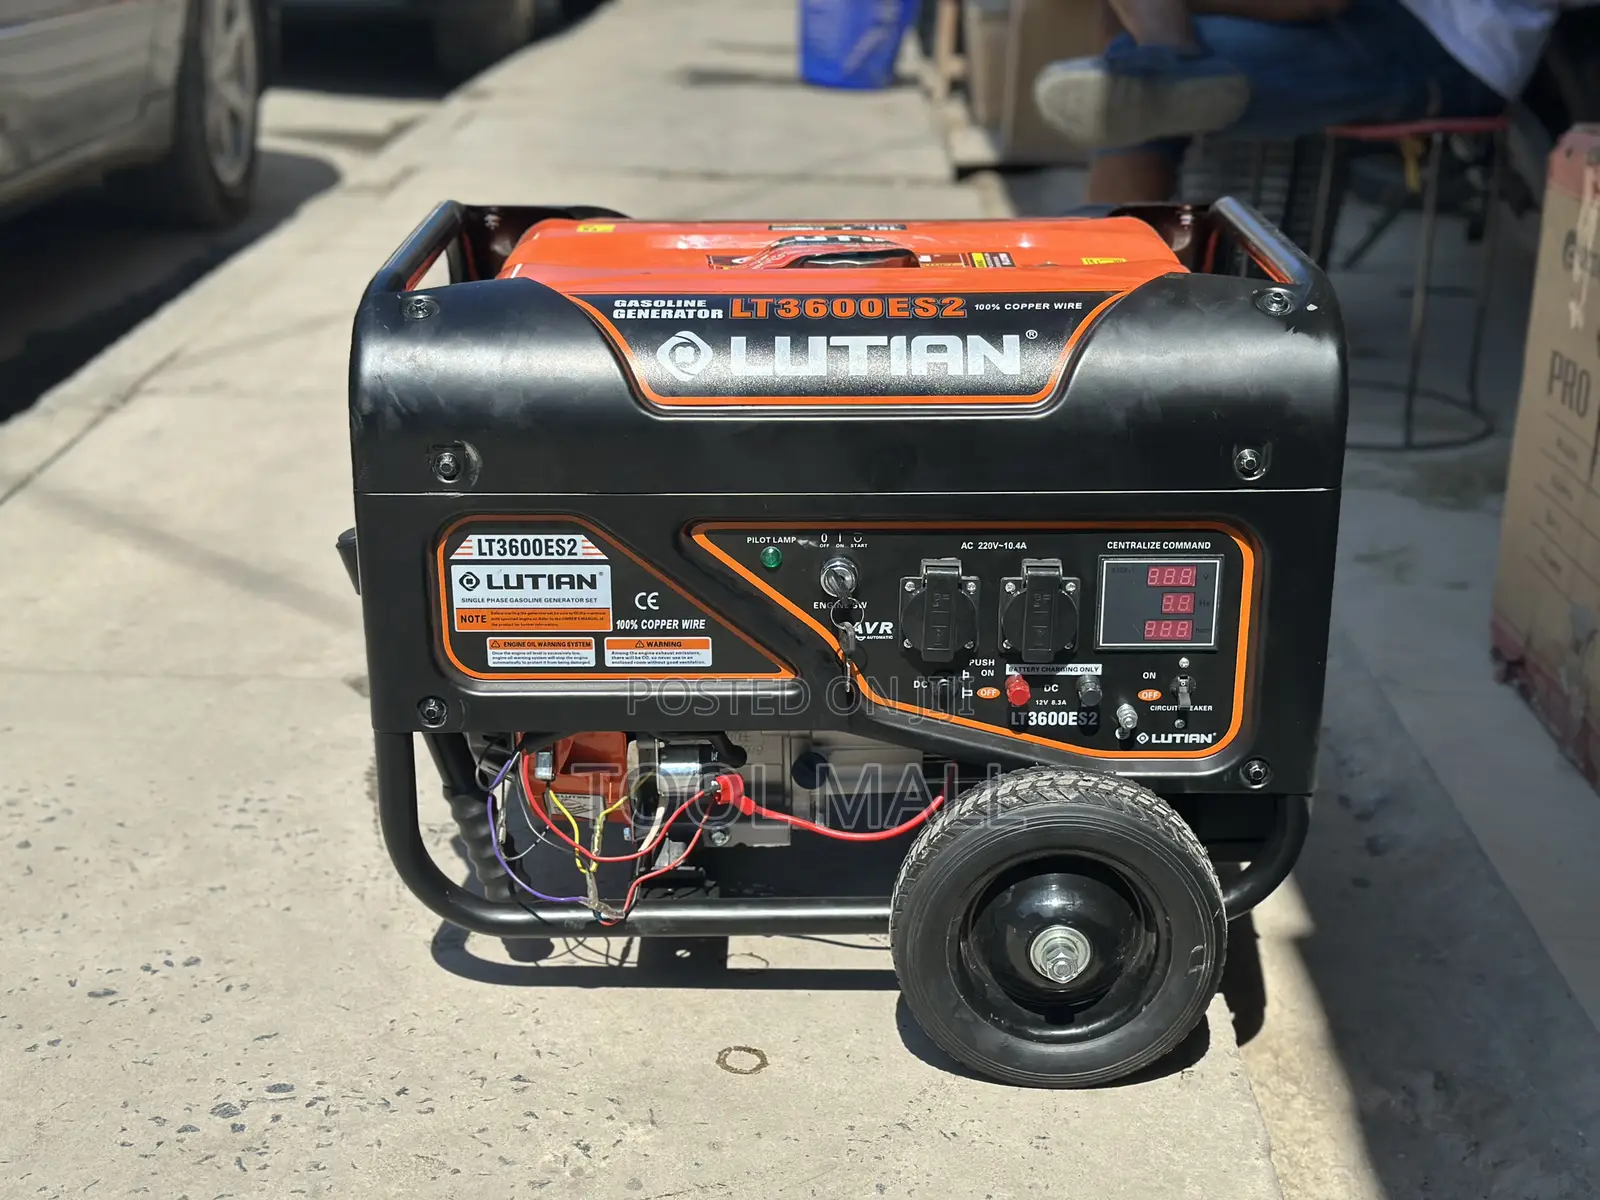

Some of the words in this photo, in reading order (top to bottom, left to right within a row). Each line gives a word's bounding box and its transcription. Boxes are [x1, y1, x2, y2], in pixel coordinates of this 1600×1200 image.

[614, 300, 706, 308] GASOLINE
[729, 298, 968, 319] LT3600ES2
[1054, 302, 1082, 310] WIRE
[613, 309, 723, 318] GENERATOR
[478, 538, 578, 556] LT3600ES2
[961, 542, 974, 550] AC
[486, 574, 597, 590] LUTIAN
[460, 614, 486, 623] NOTE
[616, 620, 638, 630] 100%
[641, 620, 679, 630] COPPER
[682, 620, 706, 630] WIRE
[854, 622, 893, 634] AVR
[1044, 684, 1058, 692] DC
[1011, 711, 1098, 726] LT3600ES2
[1152, 734, 1212, 743] LUTIAN
